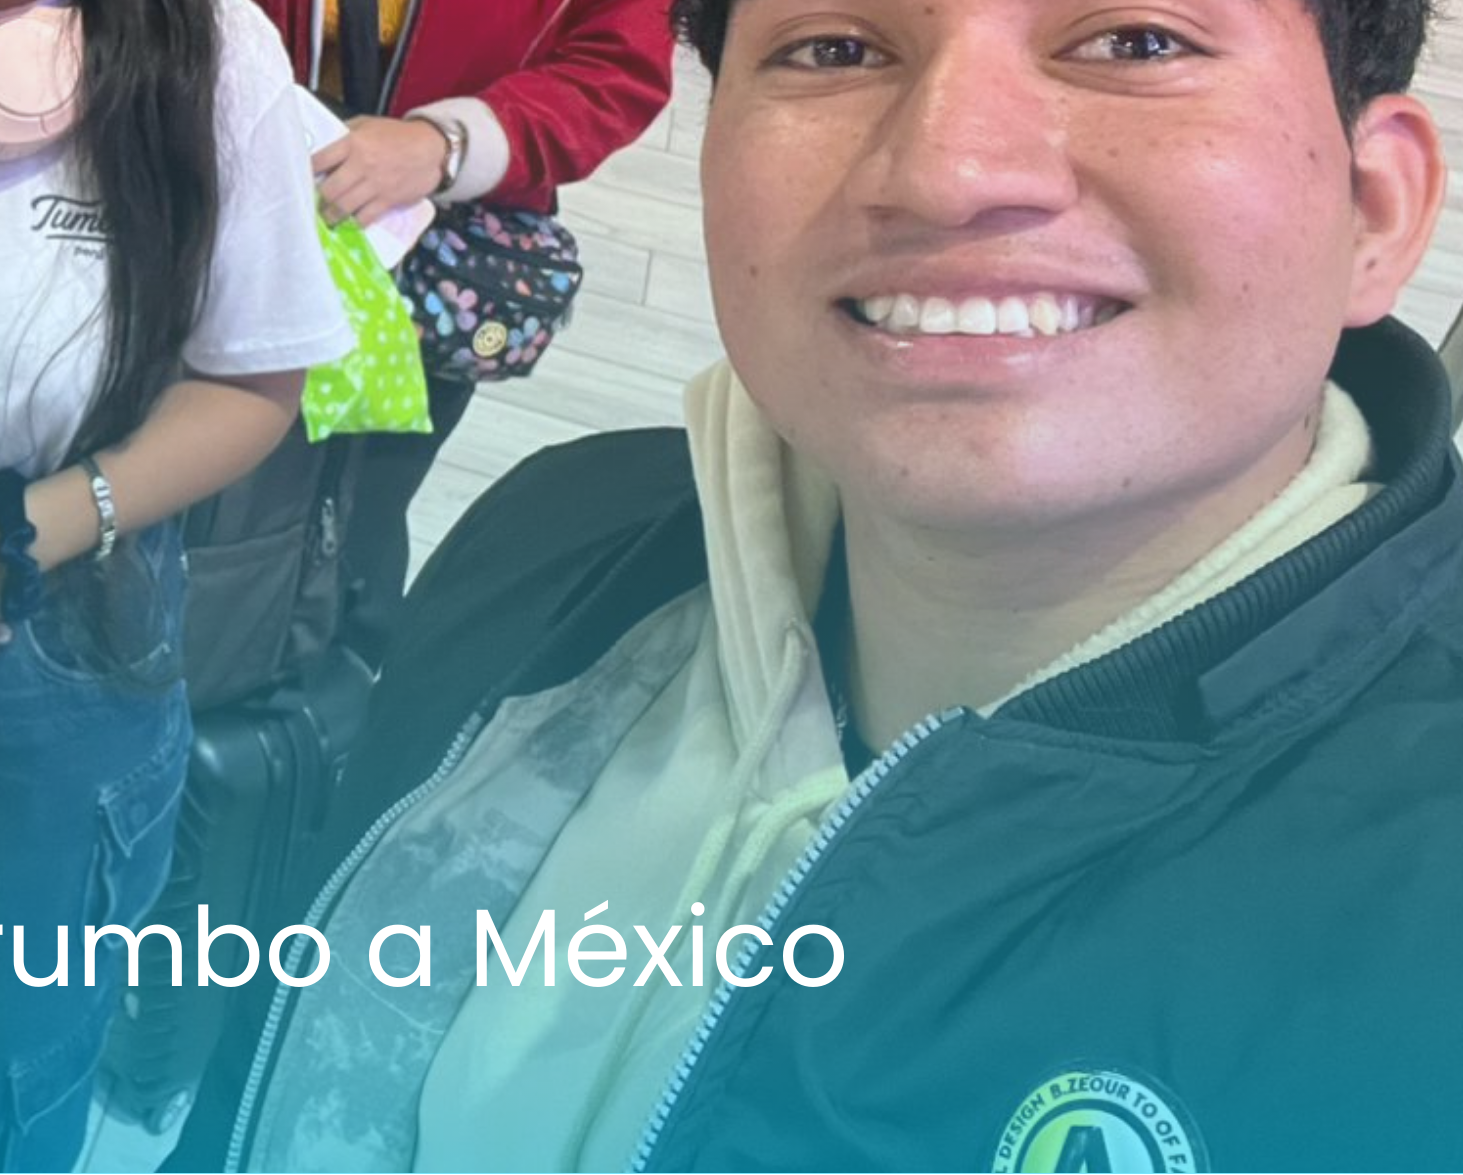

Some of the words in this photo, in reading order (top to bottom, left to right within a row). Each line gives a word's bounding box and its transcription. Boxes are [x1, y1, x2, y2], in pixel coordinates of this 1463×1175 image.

[999, 1093, 1045, 1159] DESIGN
[1133, 1092, 1158, 1119] TO
[1155, 1120, 1181, 1147] OF
